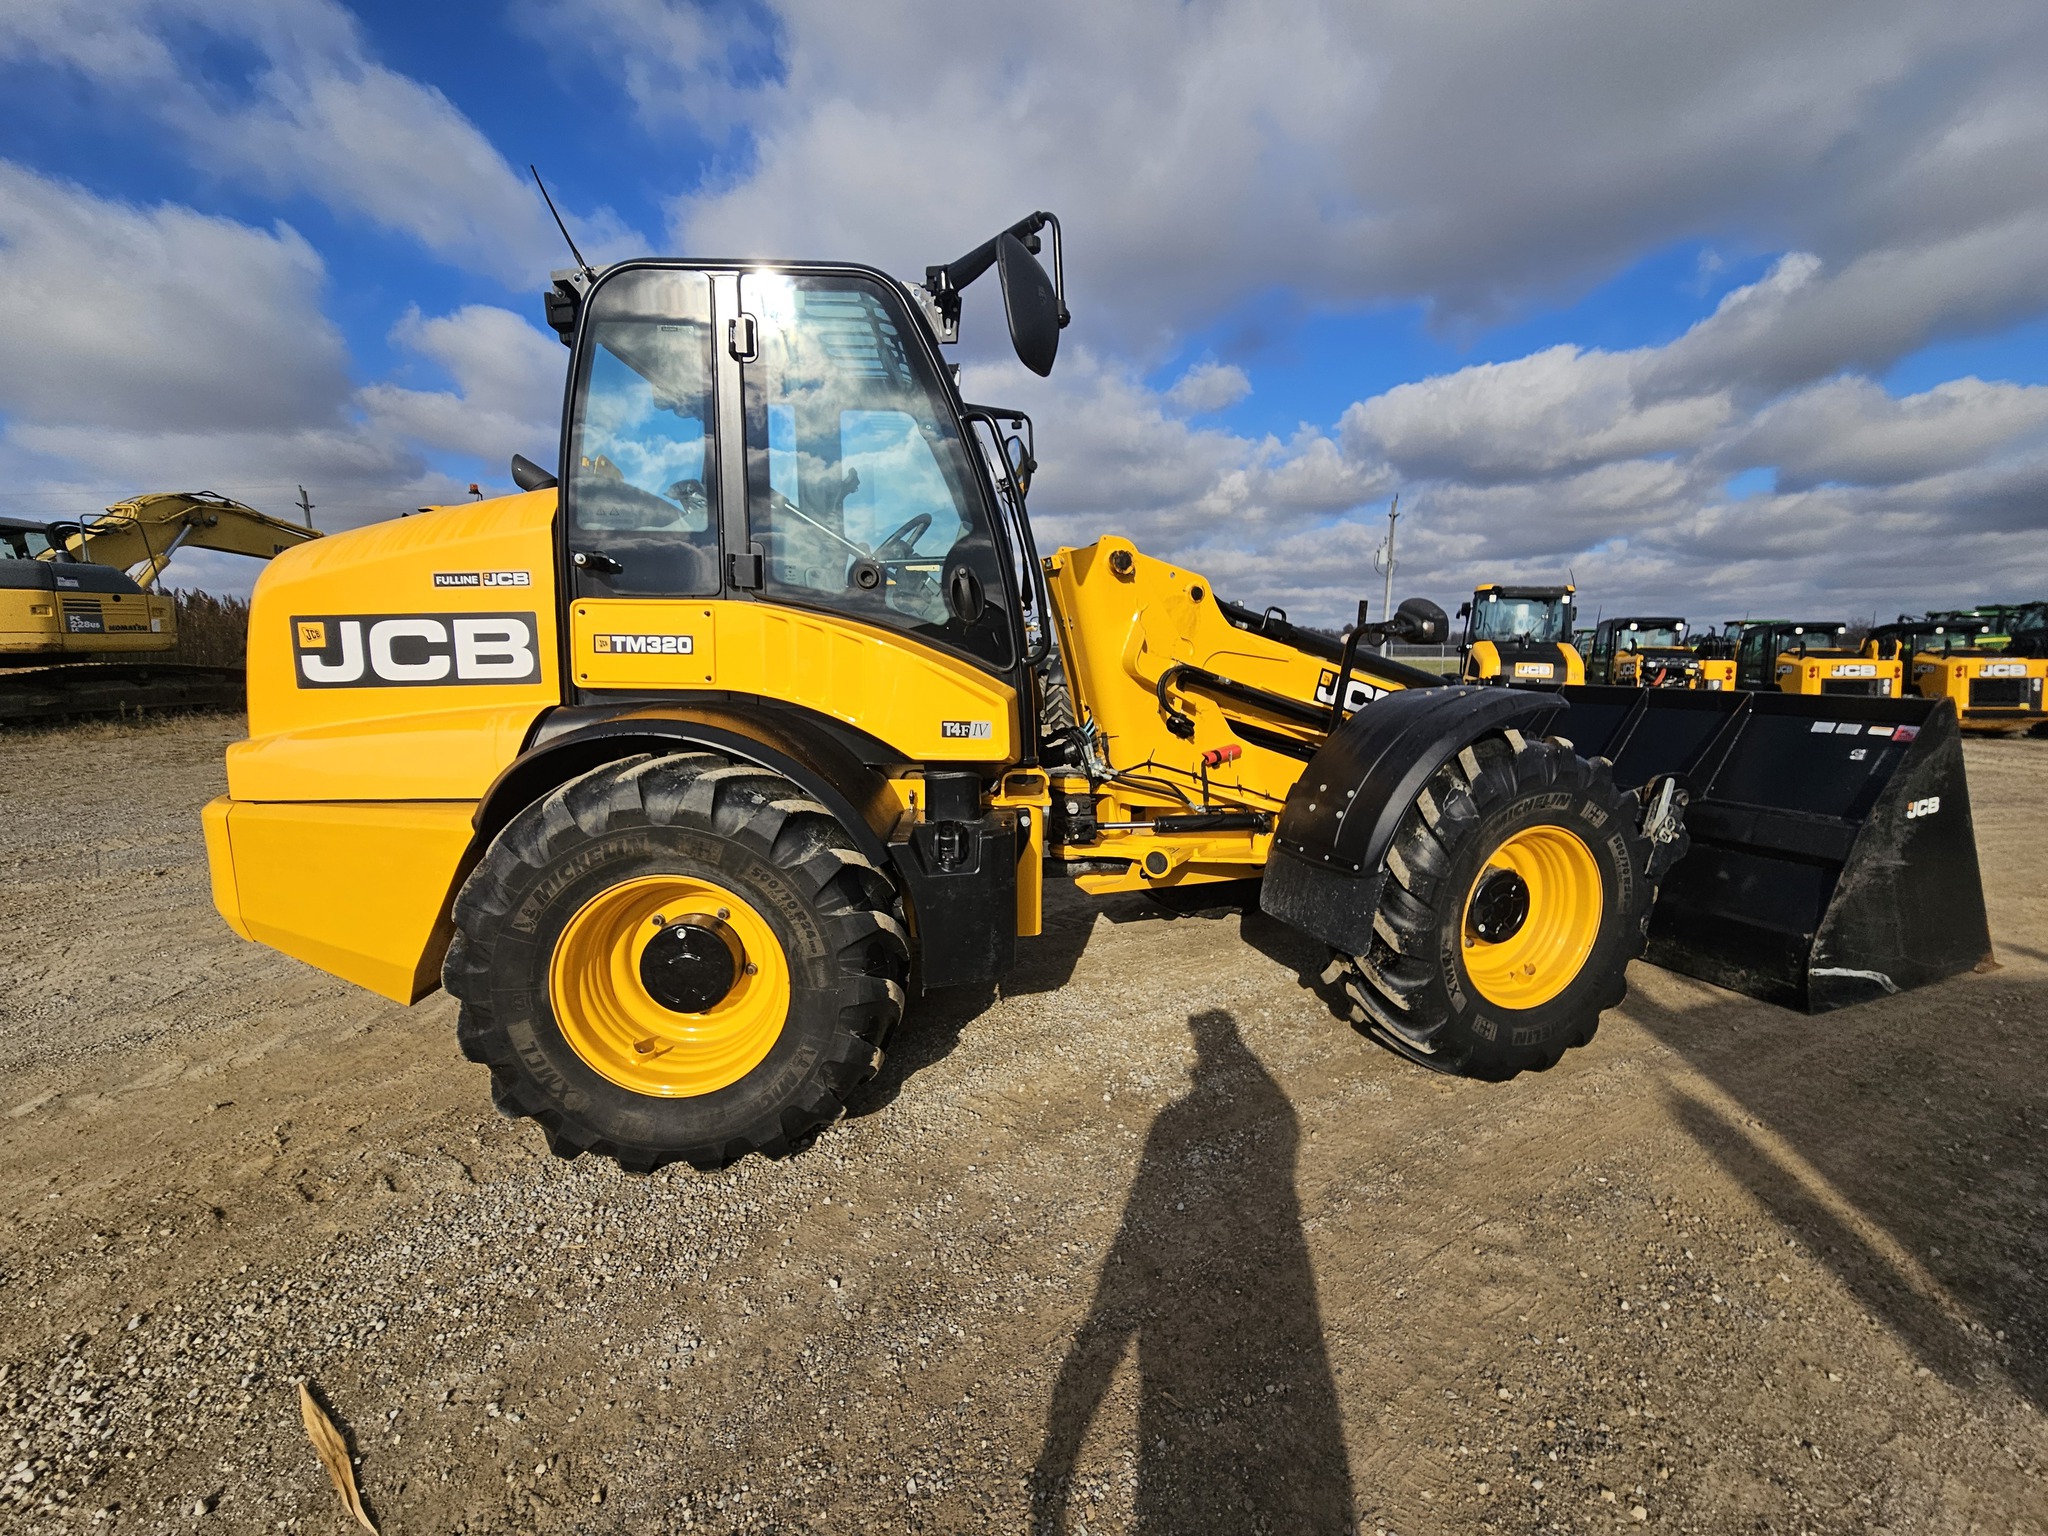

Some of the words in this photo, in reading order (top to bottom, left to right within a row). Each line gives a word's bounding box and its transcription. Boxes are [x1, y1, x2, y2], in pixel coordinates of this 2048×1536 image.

[436, 575, 479, 586] FULLINE
[484, 573, 529, 586] JCB
[109, 624, 147, 632] KOMATSU
[301, 619, 534, 682] JCB
[611, 635, 692, 654] TM320
[1518, 665, 1550, 675] JCB
[1620, 663, 1635, 676] JCB
[1832, 665, 1876, 677] JCB
[1980, 664, 2026, 677] JCB
[1317, 675, 1390, 713] JC
[1907, 797, 1940, 819] JCB
[1613, 836, 1630, 875] 500/70
[535, 834, 650, 903] MICHELIN
[750, 867, 799, 910] 500/70
[795, 911, 817, 939] R24
[521, 1041, 577, 1099] XMCL
